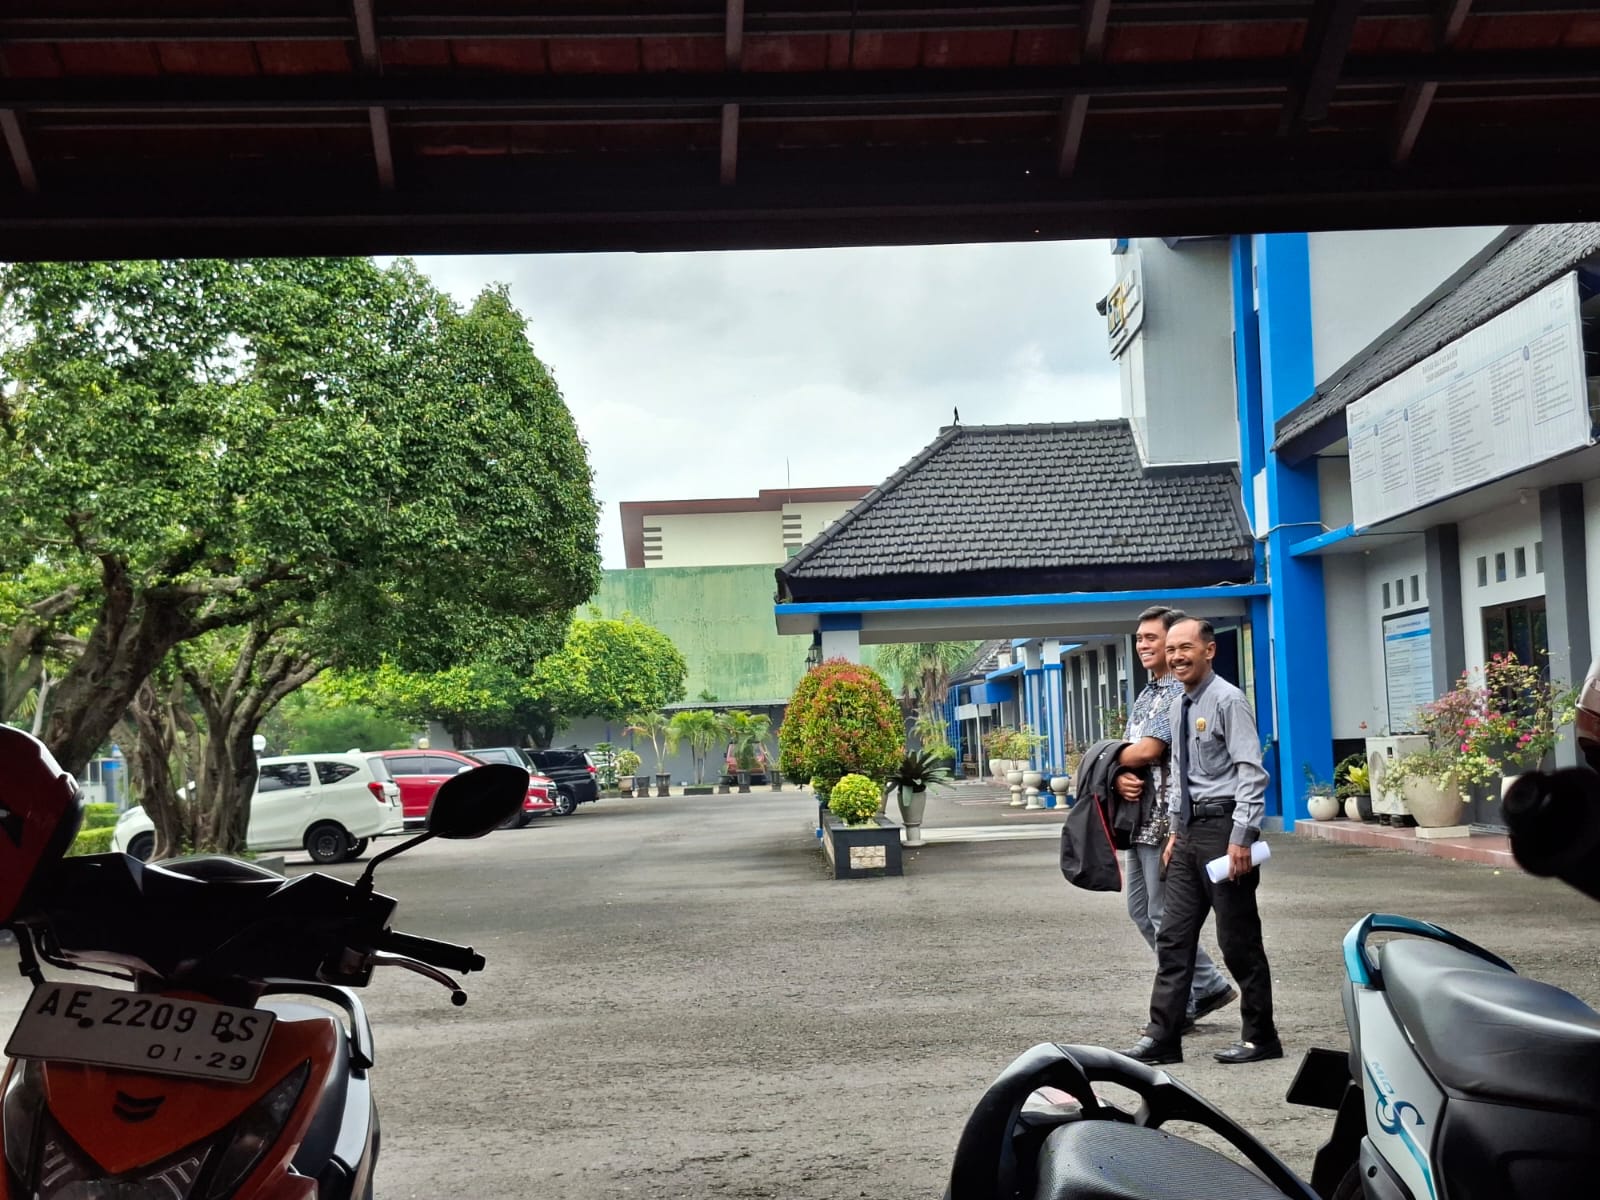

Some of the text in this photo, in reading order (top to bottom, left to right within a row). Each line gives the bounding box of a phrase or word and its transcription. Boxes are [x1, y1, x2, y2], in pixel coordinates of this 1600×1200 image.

[37, 989, 258, 1043] AE 2209 BS
